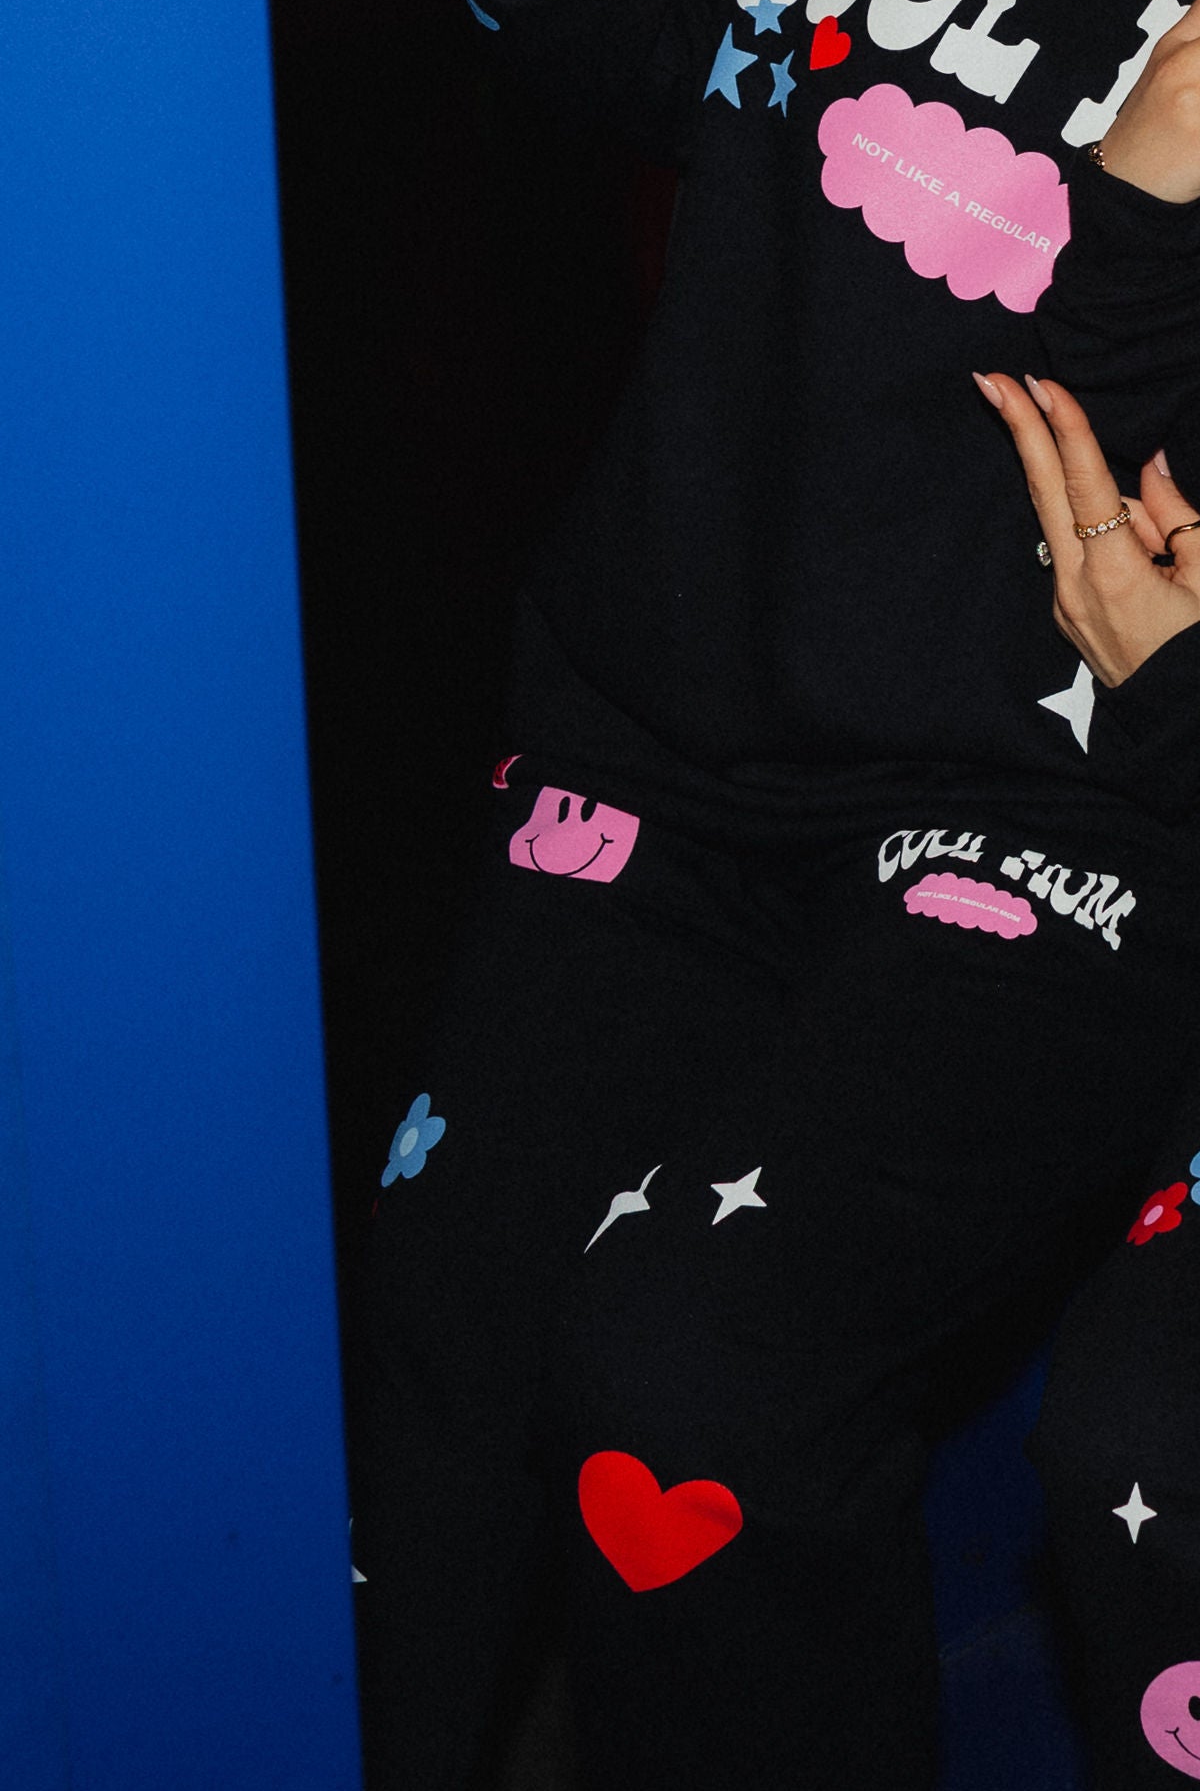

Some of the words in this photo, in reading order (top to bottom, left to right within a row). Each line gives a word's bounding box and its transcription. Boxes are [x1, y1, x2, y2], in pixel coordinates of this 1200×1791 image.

[851, 133, 895, 164] NOT
[894, 159, 945, 196] LIKE
[944, 190, 960, 207] A
[964, 200, 1051, 255] REGULAR
[932, 892, 952, 900] LIKE
[959, 897, 999, 913] REGULAR
[1000, 909, 1021, 922] MOM
